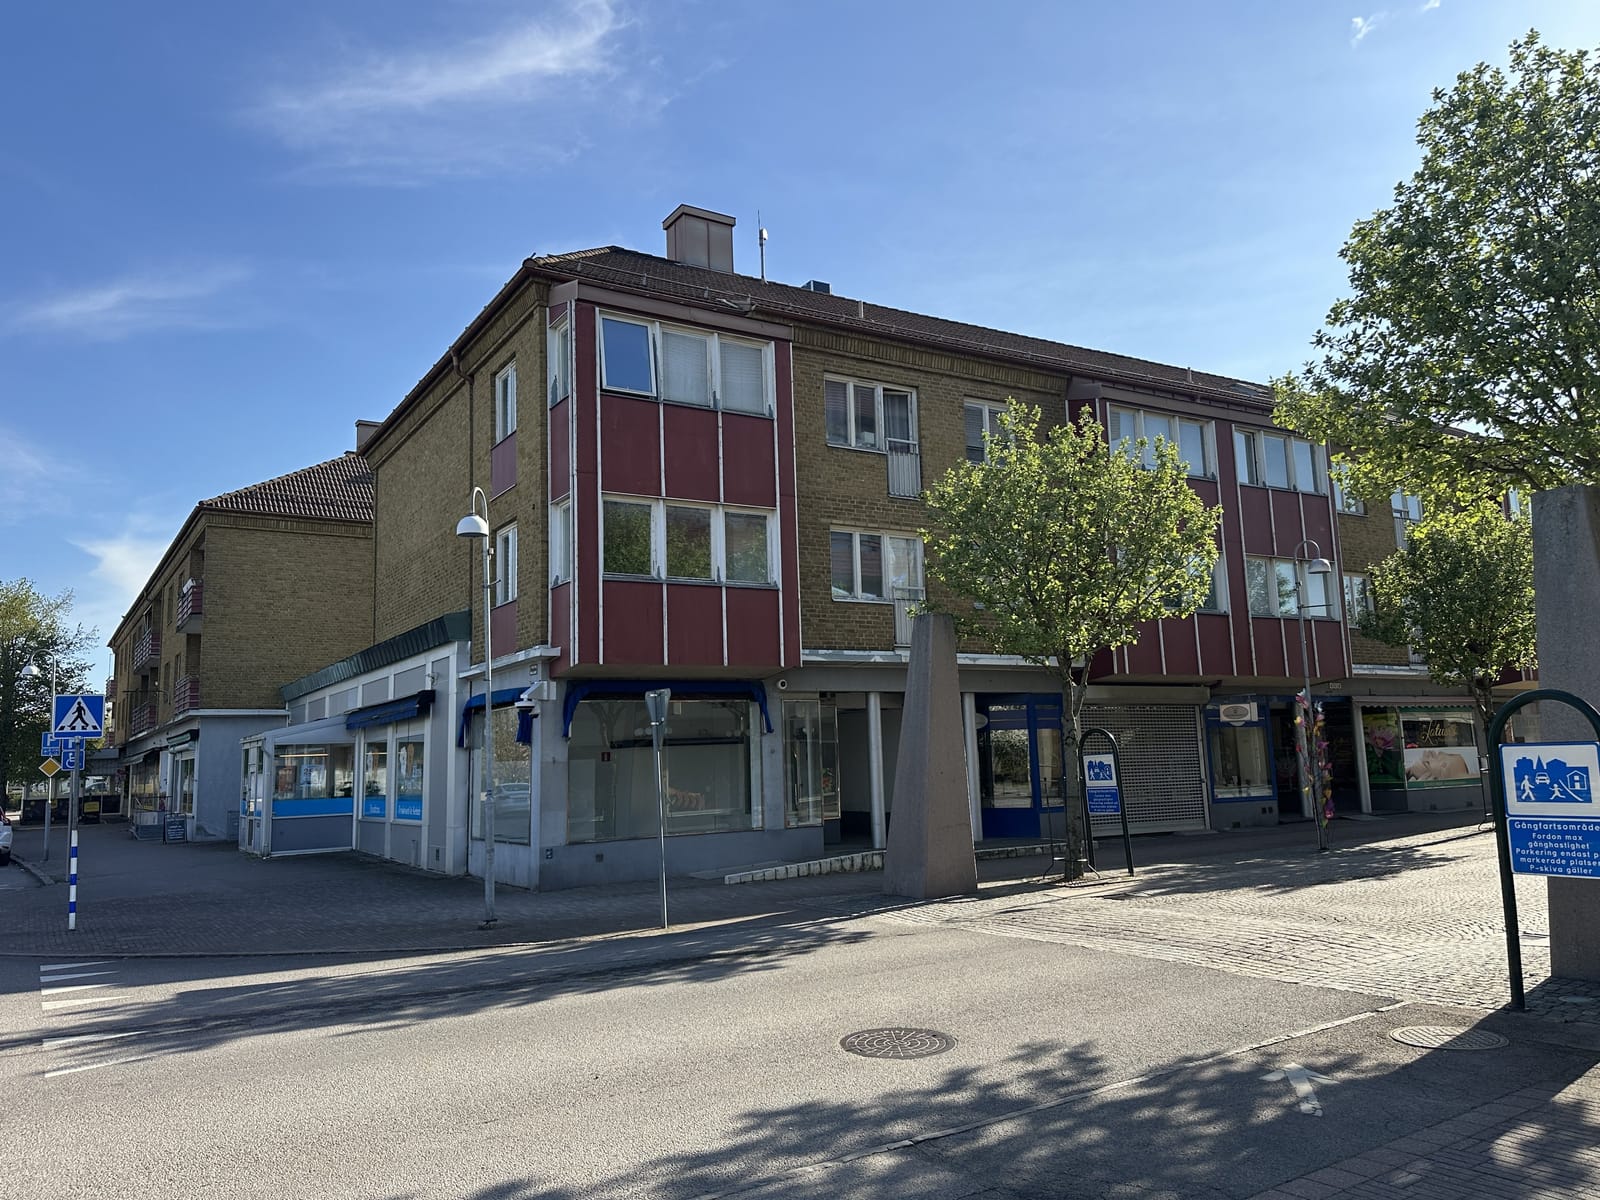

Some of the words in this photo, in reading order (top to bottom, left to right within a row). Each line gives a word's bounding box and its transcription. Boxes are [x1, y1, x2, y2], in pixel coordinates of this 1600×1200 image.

[1514, 821, 1600, 831] Gångfartsområde
[1532, 832, 1562, 840] Fordon
[1528, 841, 1590, 850] gånghastighet
[1515, 847, 1557, 857] Parkering
[1520, 857, 1566, 865] markerade
[1529, 864, 1563, 873] P-skiva
[1566, 866, 1593, 874] gäller
